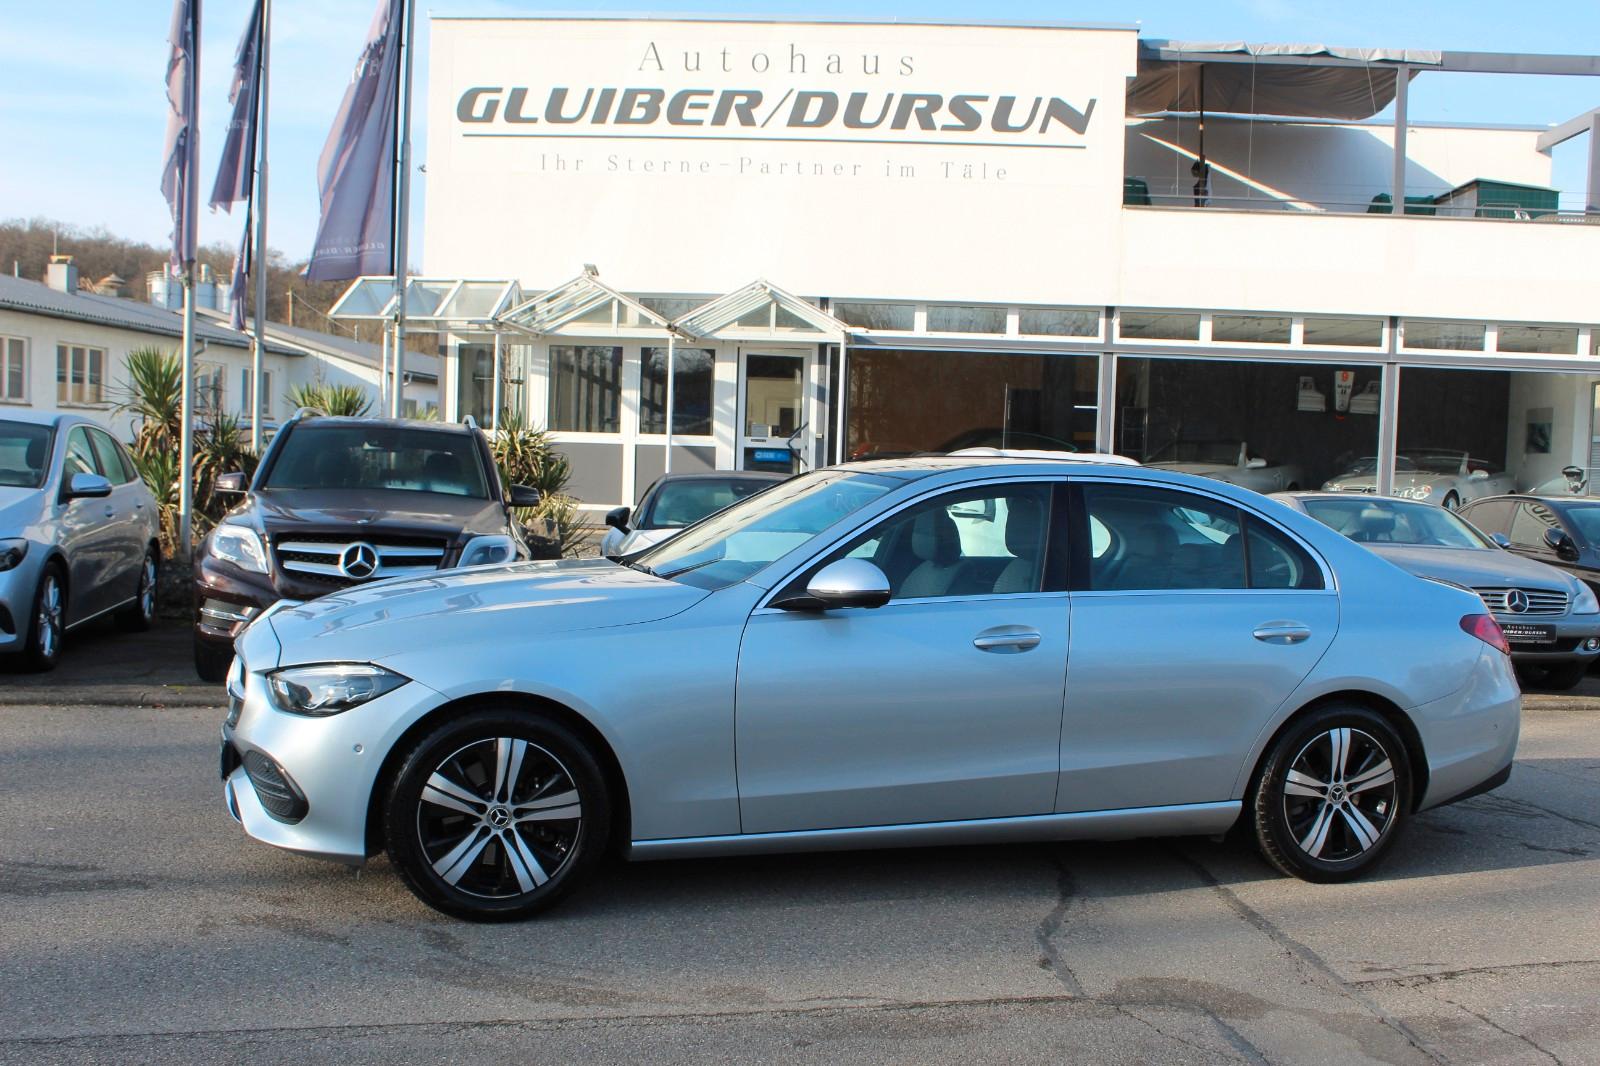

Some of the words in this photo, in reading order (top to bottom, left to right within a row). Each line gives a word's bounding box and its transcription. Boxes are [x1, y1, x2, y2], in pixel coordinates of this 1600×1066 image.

[637, 41, 915, 76] Autohaus
[456, 86, 1097, 136] GLUIBER/DURSUN
[541, 153, 584, 171] Ihr
[607, 154, 862, 177] Sterne-Partner
[885, 159, 915, 178] im
[941, 161, 1007, 180] Täle
